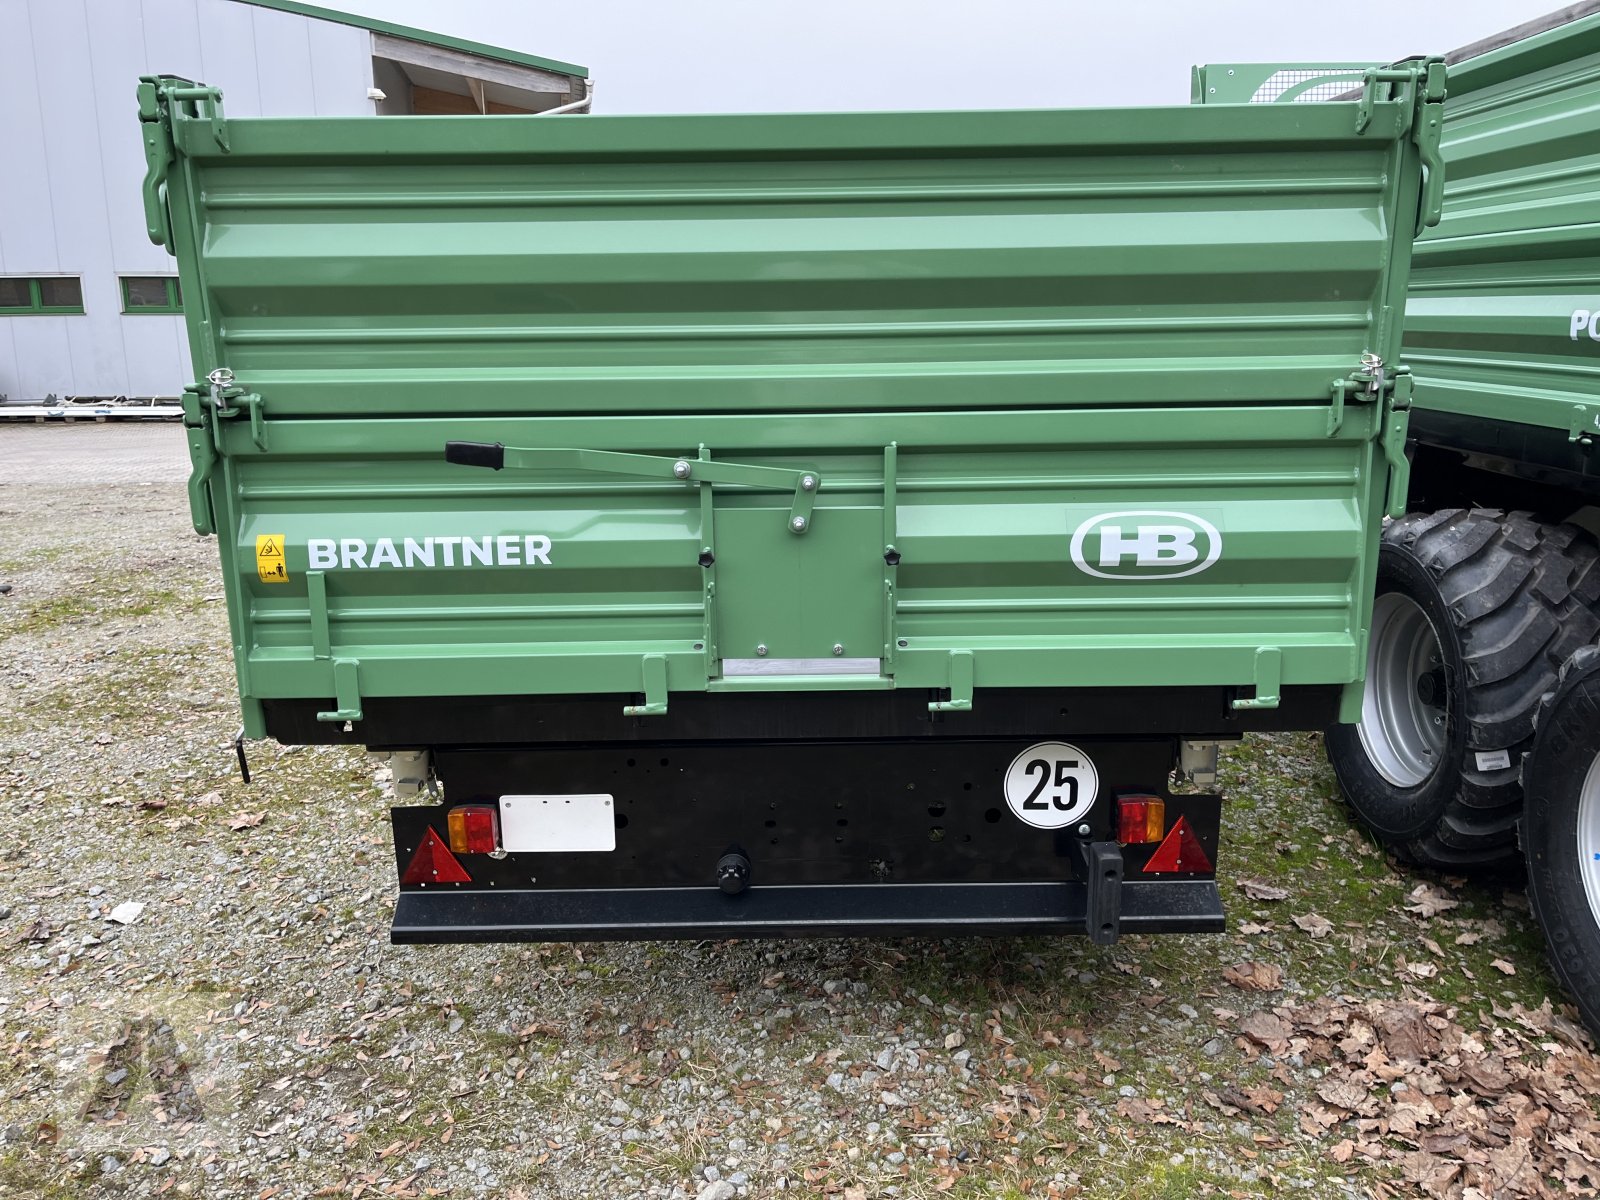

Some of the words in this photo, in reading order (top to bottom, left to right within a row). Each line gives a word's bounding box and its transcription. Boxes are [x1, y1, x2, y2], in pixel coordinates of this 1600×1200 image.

[307, 534, 552, 569] BRANTNER
[1099, 526, 1198, 566] HB
[1022, 759, 1079, 811] 25
